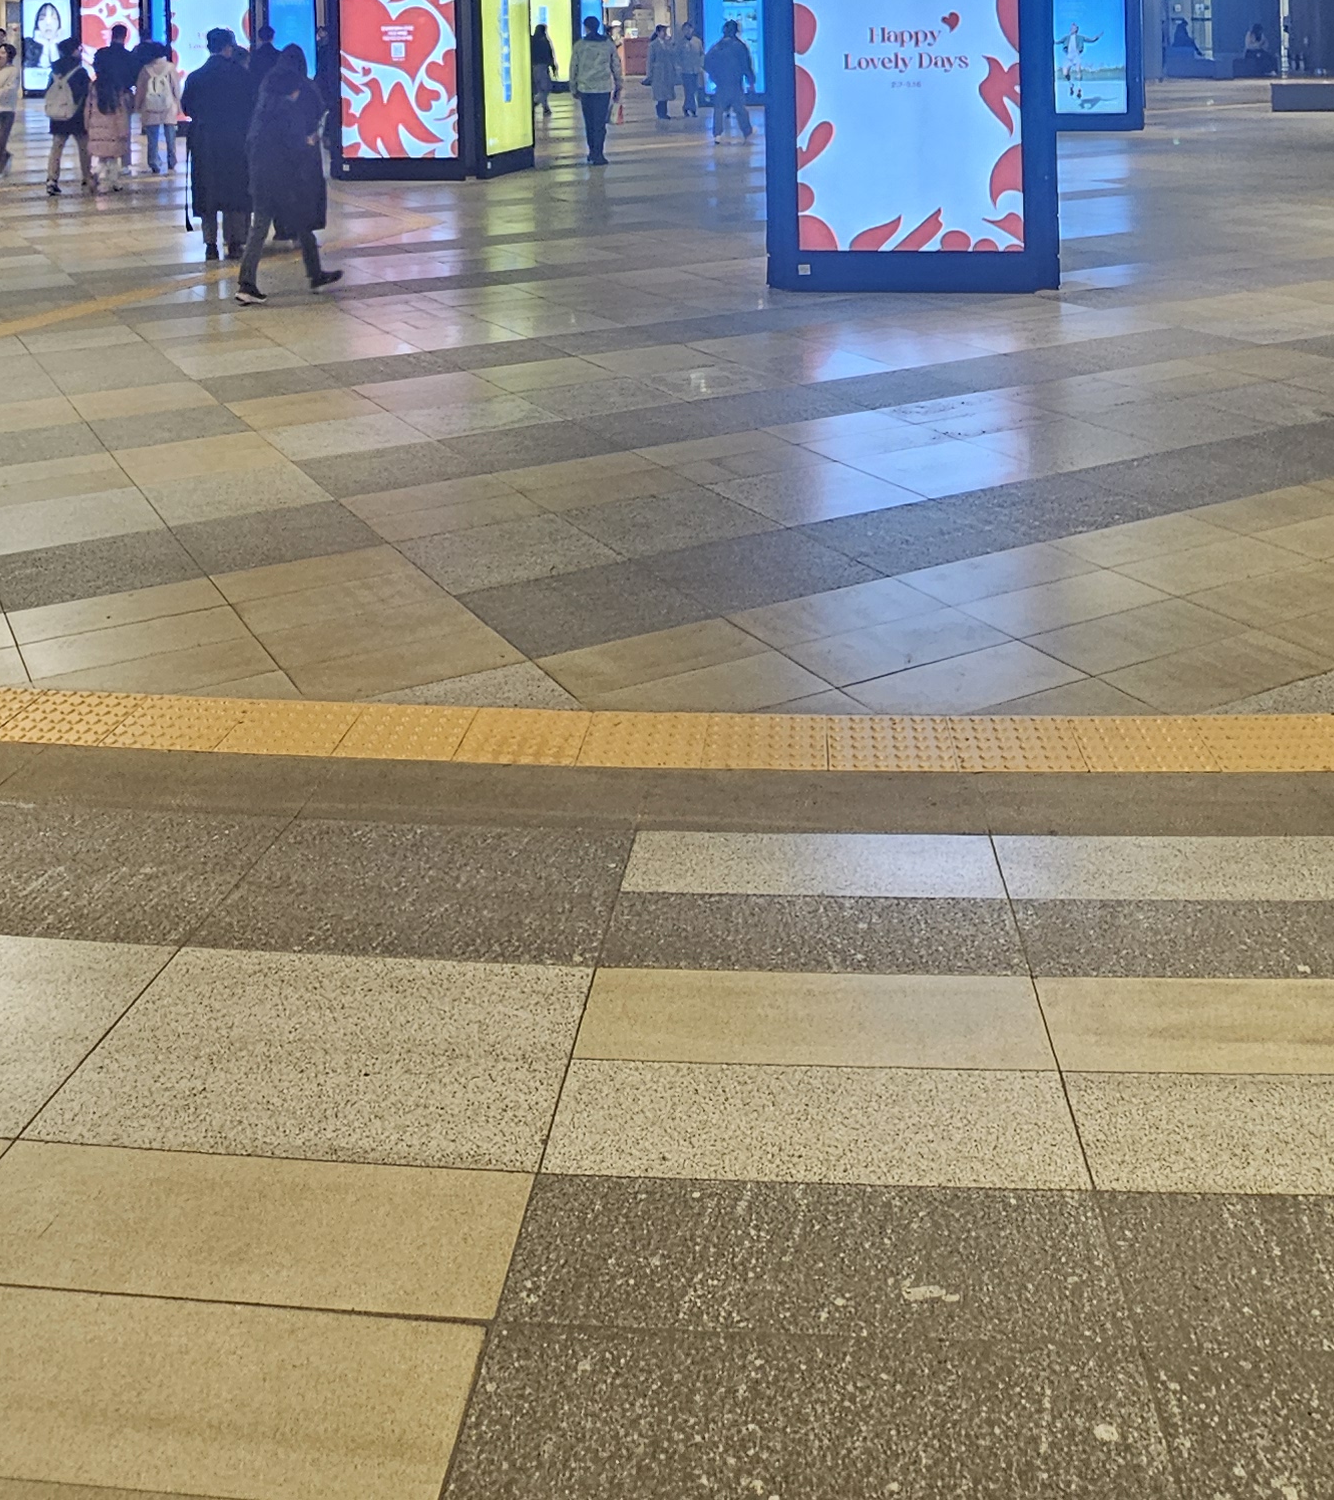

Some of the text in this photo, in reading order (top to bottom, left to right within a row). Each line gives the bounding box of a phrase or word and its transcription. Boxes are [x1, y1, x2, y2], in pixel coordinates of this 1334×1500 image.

[868, 26, 942, 48] Happy
[843, 52, 970, 74] Lovely Days
